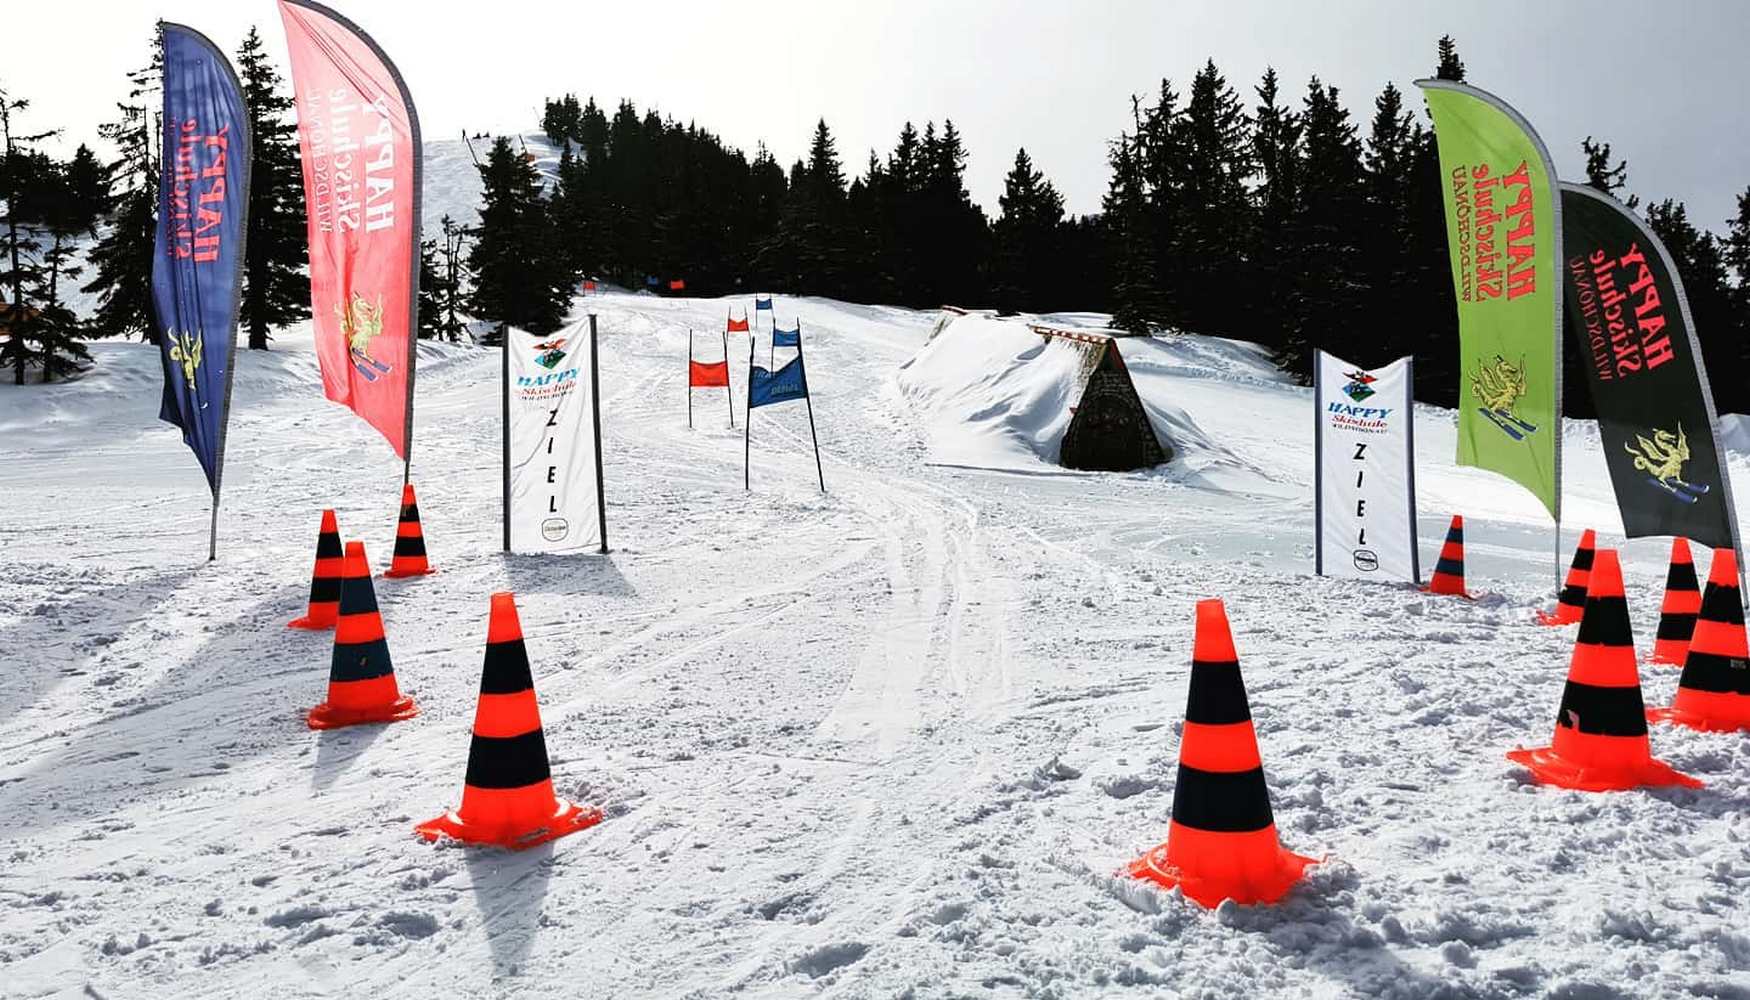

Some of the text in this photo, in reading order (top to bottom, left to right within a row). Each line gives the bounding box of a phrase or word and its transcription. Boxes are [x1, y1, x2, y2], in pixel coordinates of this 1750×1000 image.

[517, 368, 580, 387] HAPPY
[521, 381, 577, 396] Skishule
[1327, 402, 1394, 418] HAPPY
[1332, 415, 1388, 428] Skishule
[546, 408, 558, 512] ZIEL
[1353, 443, 1367, 545] ZIEL
